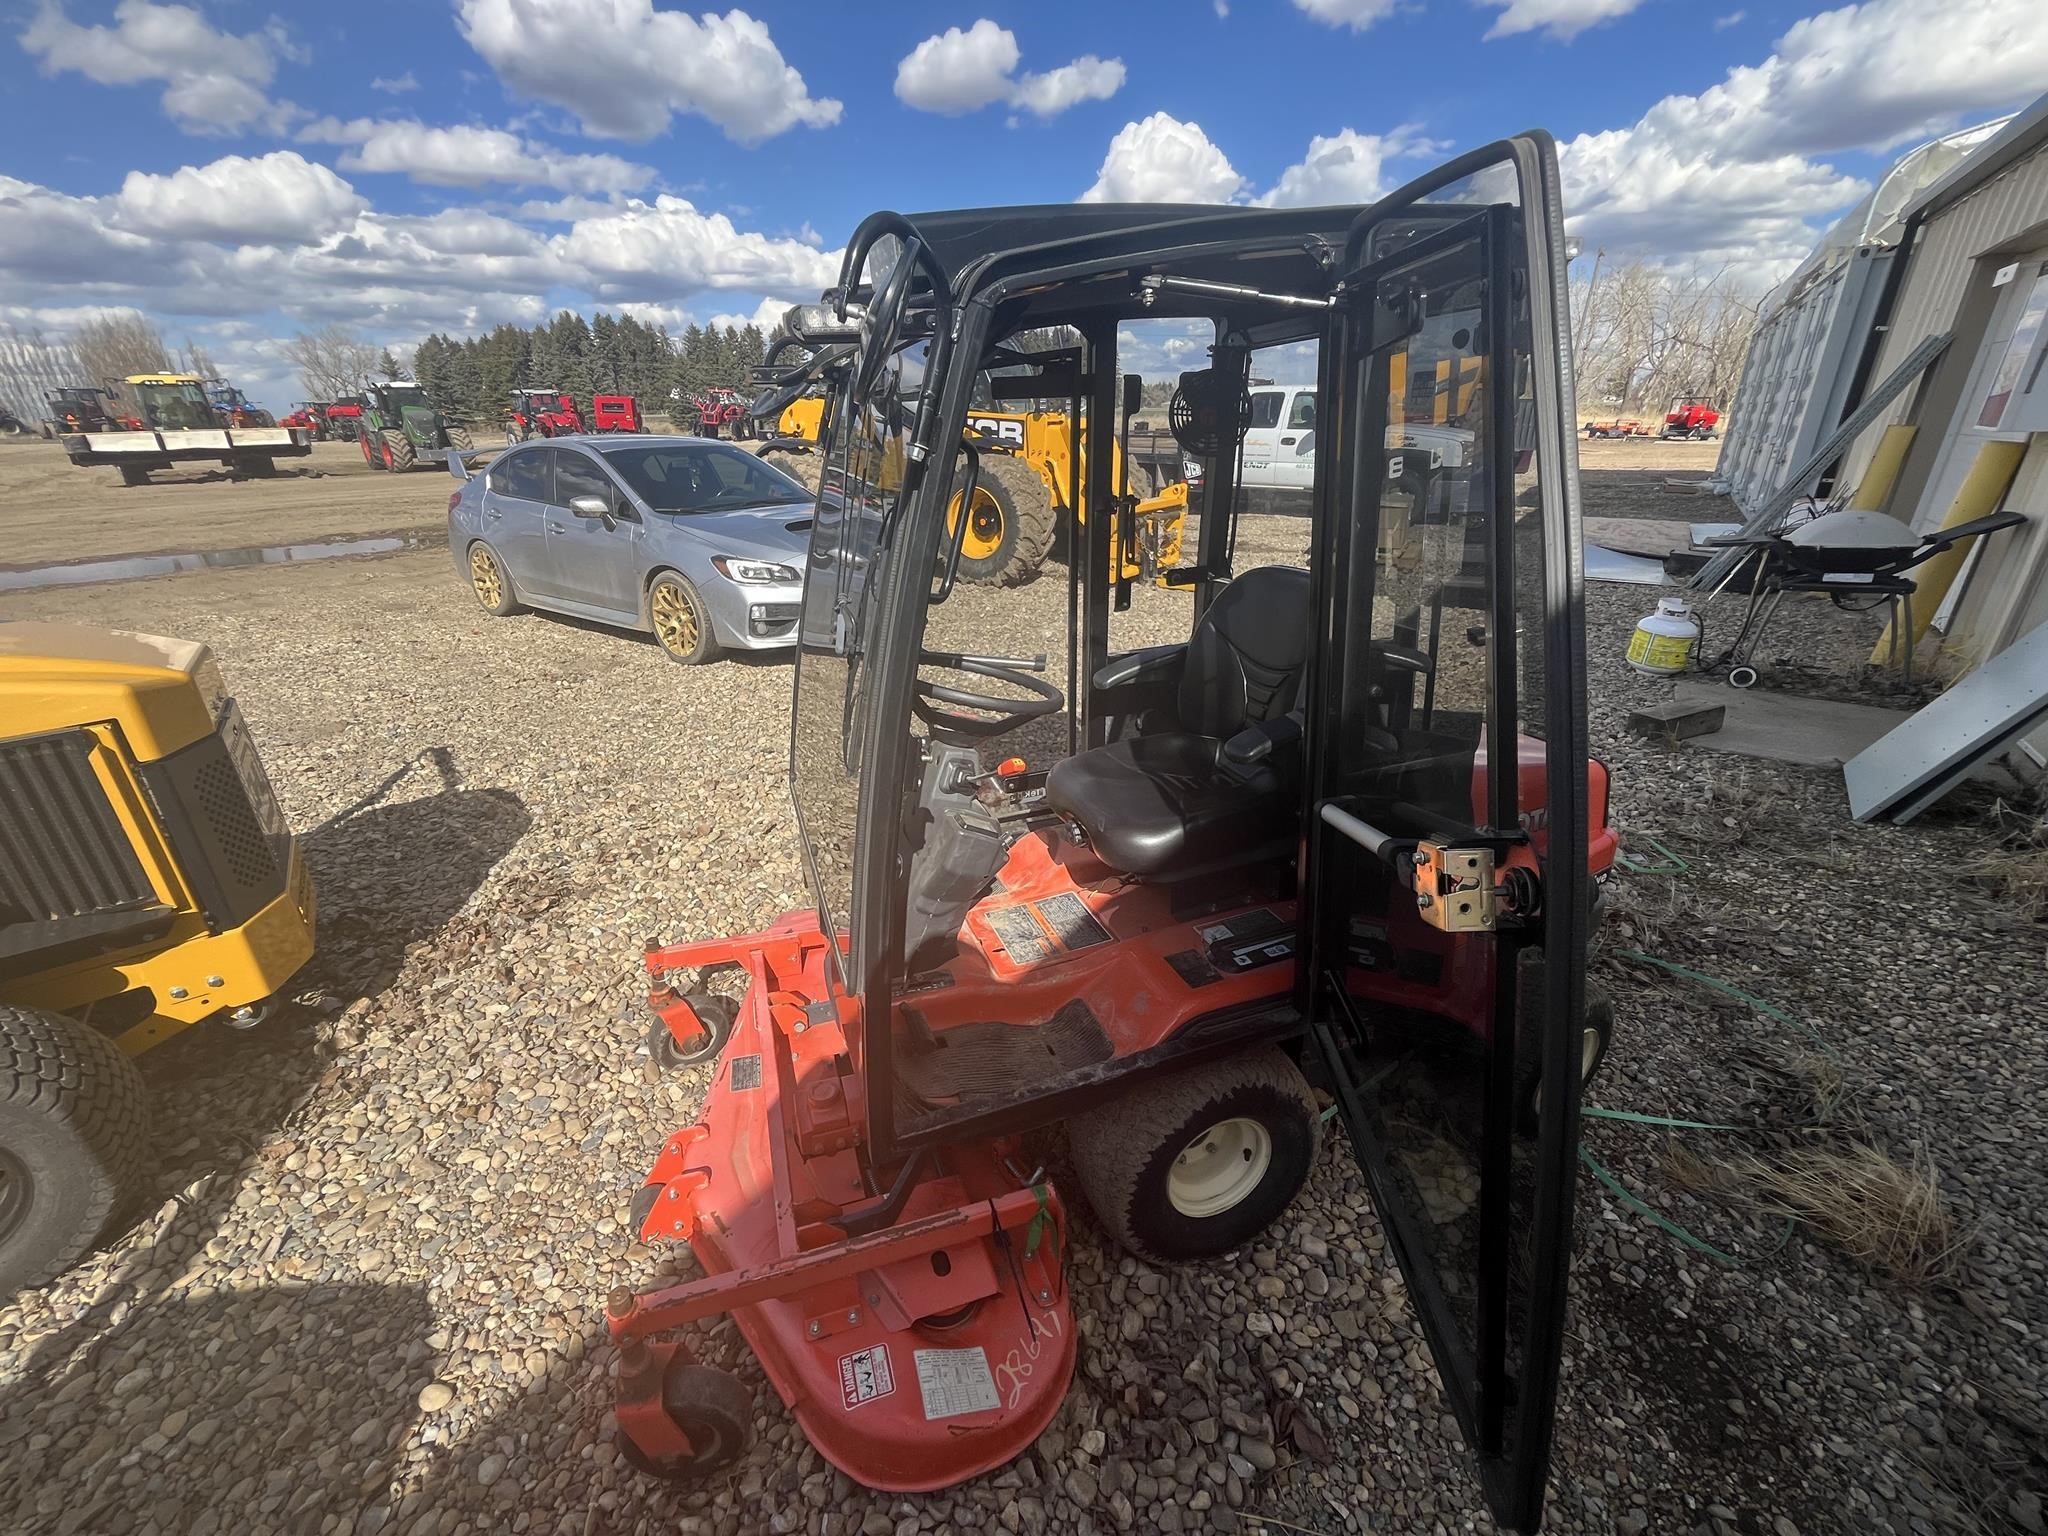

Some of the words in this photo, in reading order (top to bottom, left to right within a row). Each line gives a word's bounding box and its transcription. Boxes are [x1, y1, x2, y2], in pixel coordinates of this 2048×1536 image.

[966, 419, 1022, 444] CB
[1243, 461, 1270, 469] ENDT
[842, 1357, 856, 1393] DANGER
[995, 1311, 1062, 1410] 28697
